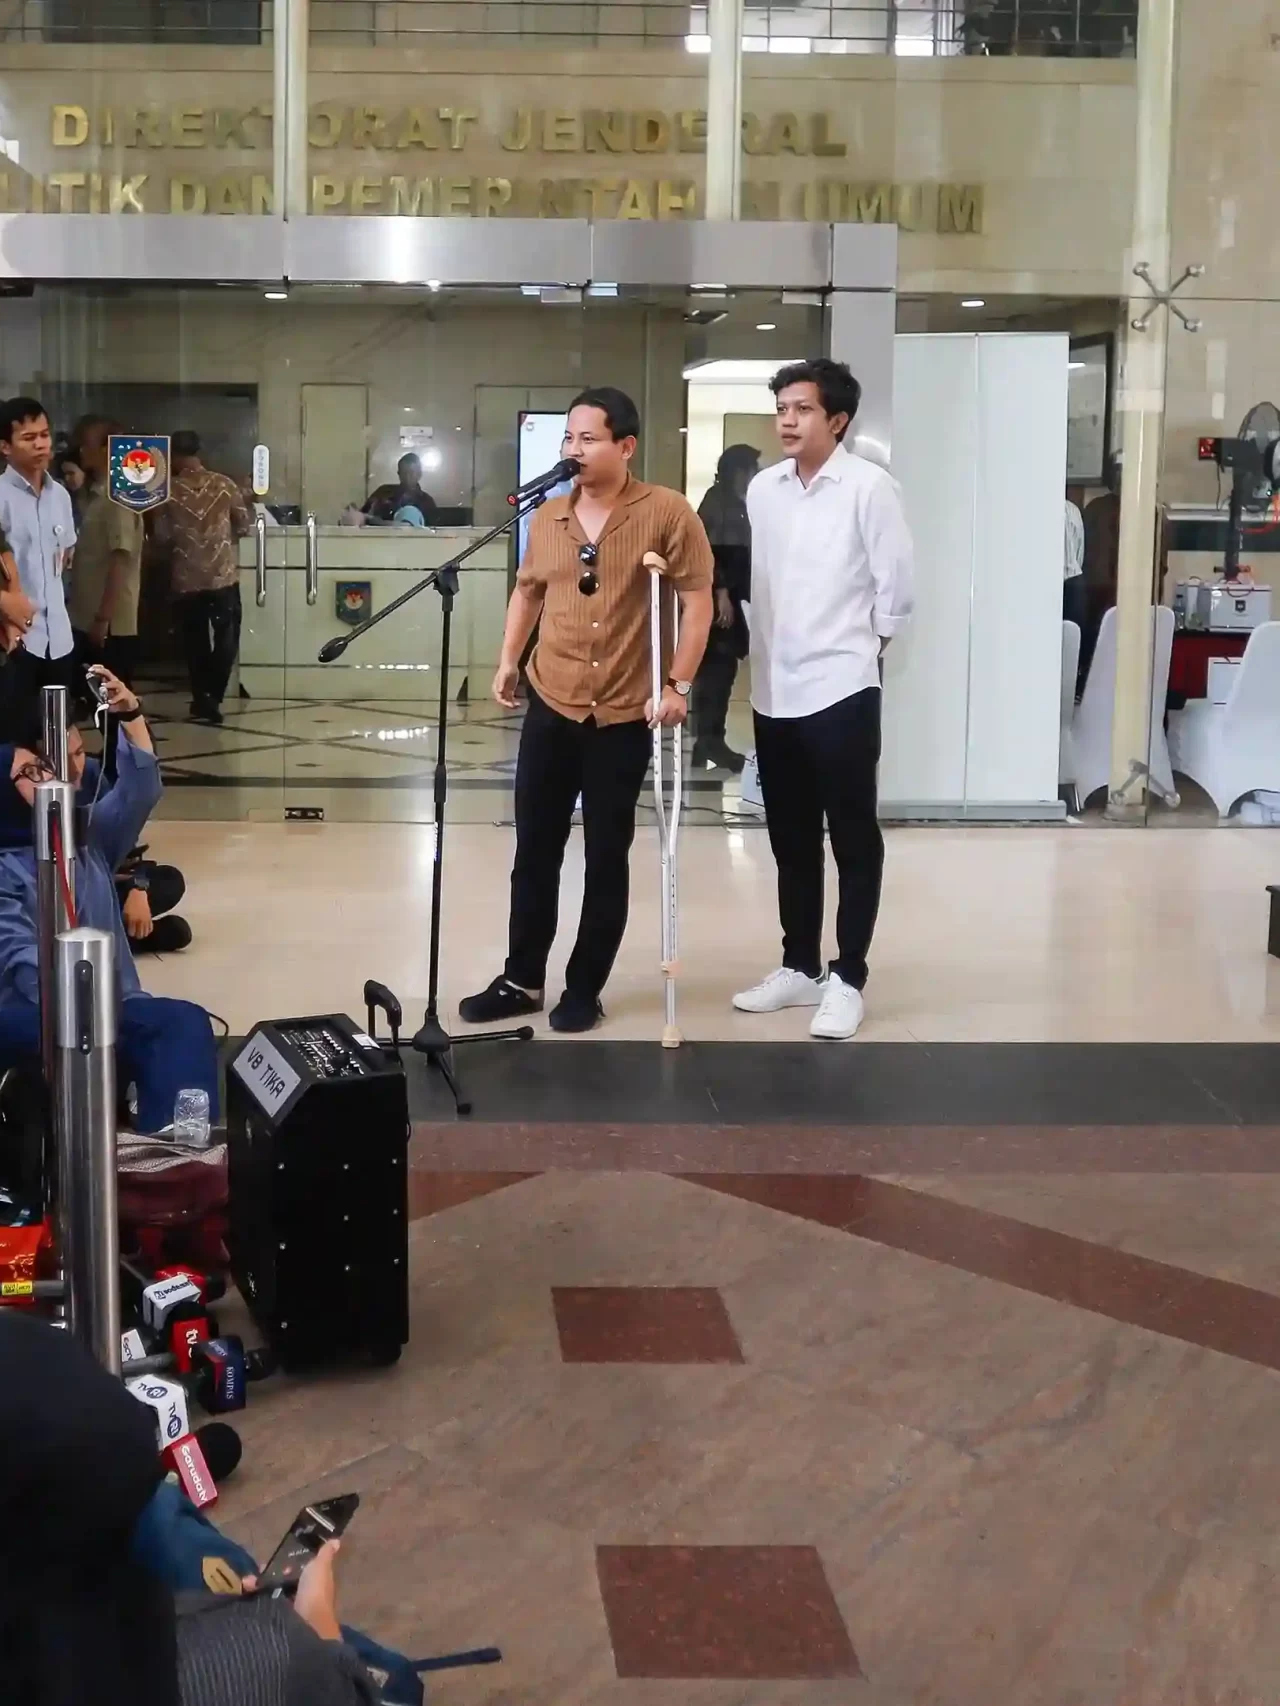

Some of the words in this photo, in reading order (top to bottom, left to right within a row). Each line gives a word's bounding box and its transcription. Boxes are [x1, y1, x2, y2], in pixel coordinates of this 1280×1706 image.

[501, 108, 847, 156] JENDERAL
[170, 173, 275, 215] DAN
[259, 1063, 286, 1100] TIKA
[226, 1366, 235, 1399] KOMPAS
